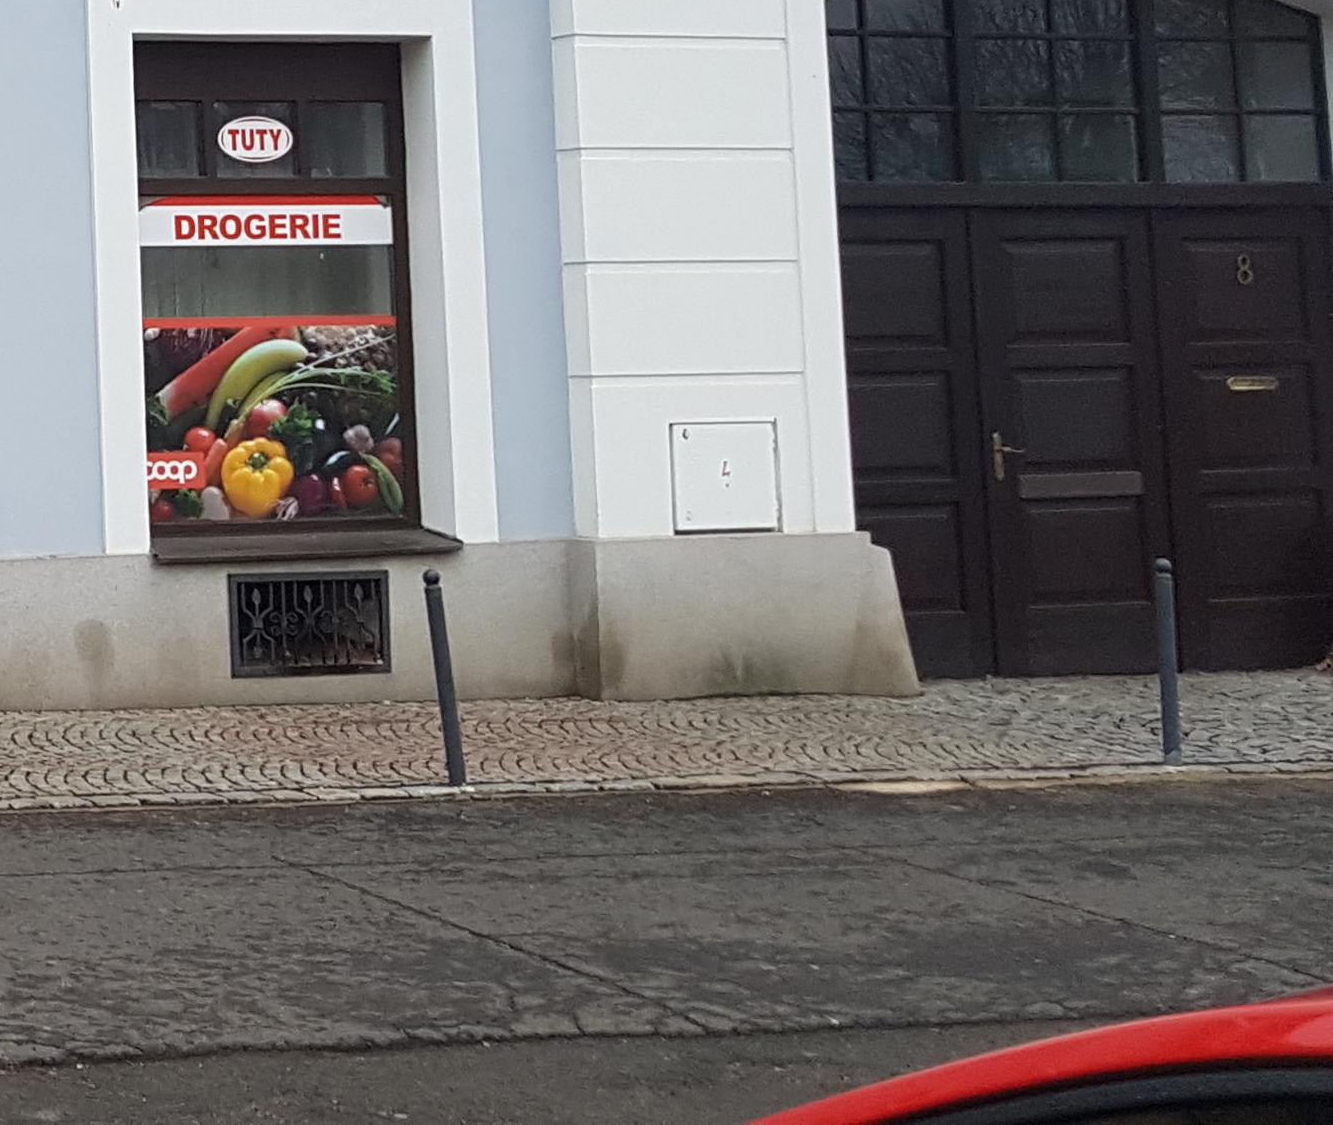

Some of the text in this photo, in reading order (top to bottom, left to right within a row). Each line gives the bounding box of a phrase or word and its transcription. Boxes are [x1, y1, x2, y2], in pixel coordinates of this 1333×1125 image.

[227, 128, 282, 151] TUTY
[174, 214, 341, 240] DROGERIE
[1237, 255, 1253, 285] 8
